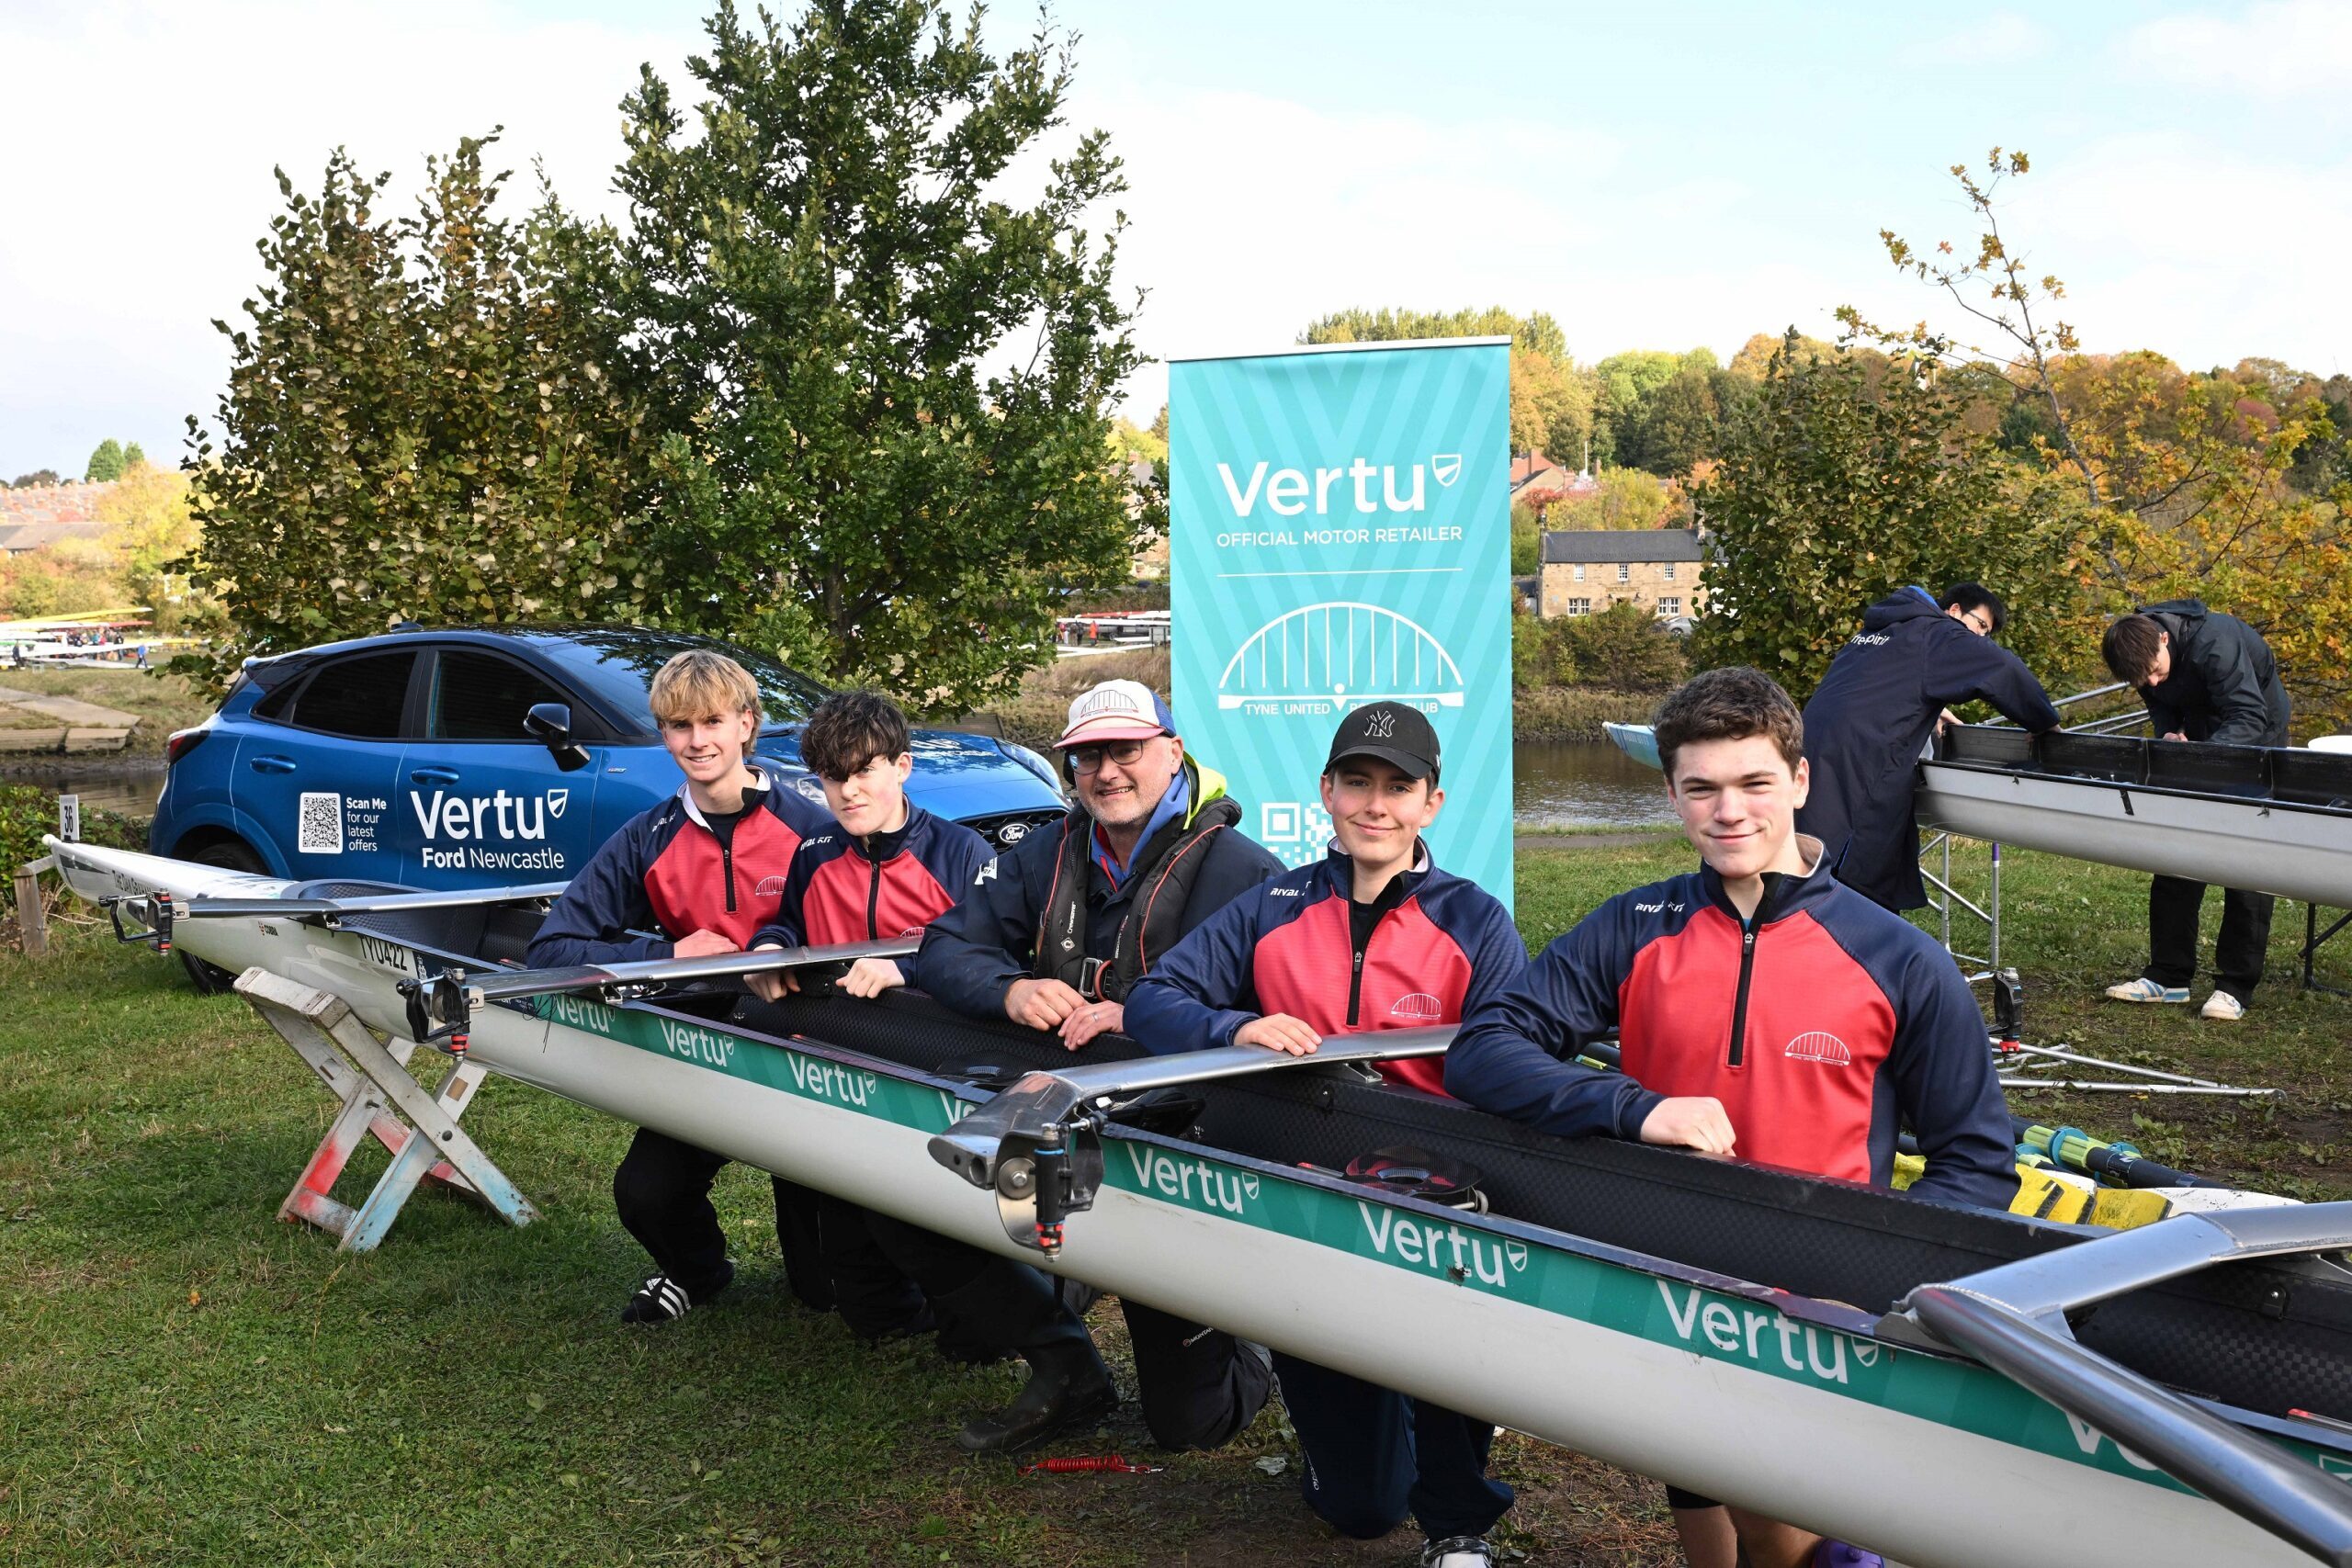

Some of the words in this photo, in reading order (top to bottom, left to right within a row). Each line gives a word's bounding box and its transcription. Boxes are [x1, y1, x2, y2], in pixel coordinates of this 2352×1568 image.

[1216, 457, 1425, 517] Vertu
[1216, 530, 1298, 548] OFFICIAL
[1304, 528, 1369, 545] MOTOR
[1374, 525, 1463, 543] RETAILER
[1245, 704, 1279, 716] TYNE
[1284, 702, 1330, 715] UNITED
[346, 796, 370, 810] Scan
[372, 797, 387, 810] Me
[410, 789, 545, 840] Vertu
[63, 805, 74, 833] 36
[347, 812, 361, 824] for
[363, 814, 379, 825] our
[347, 825, 375, 838] latest
[348, 840, 378, 852] offers
[1005, 827, 1025, 840] Ford
[422, 846, 466, 868] Ford
[470, 847, 565, 870] Newcastle
[1270, 887, 1300, 897] RIVAL
[357, 933, 408, 972] TYU422
[555, 994, 610, 1033] Vertu
[659, 1018, 728, 1067] Vertu
[786, 1051, 867, 1107] Vertu
[1125, 1142, 1243, 1214] Vertu
[1358, 1201, 1506, 1288] Vertu
[1657, 1279, 1849, 1384] Vertu
